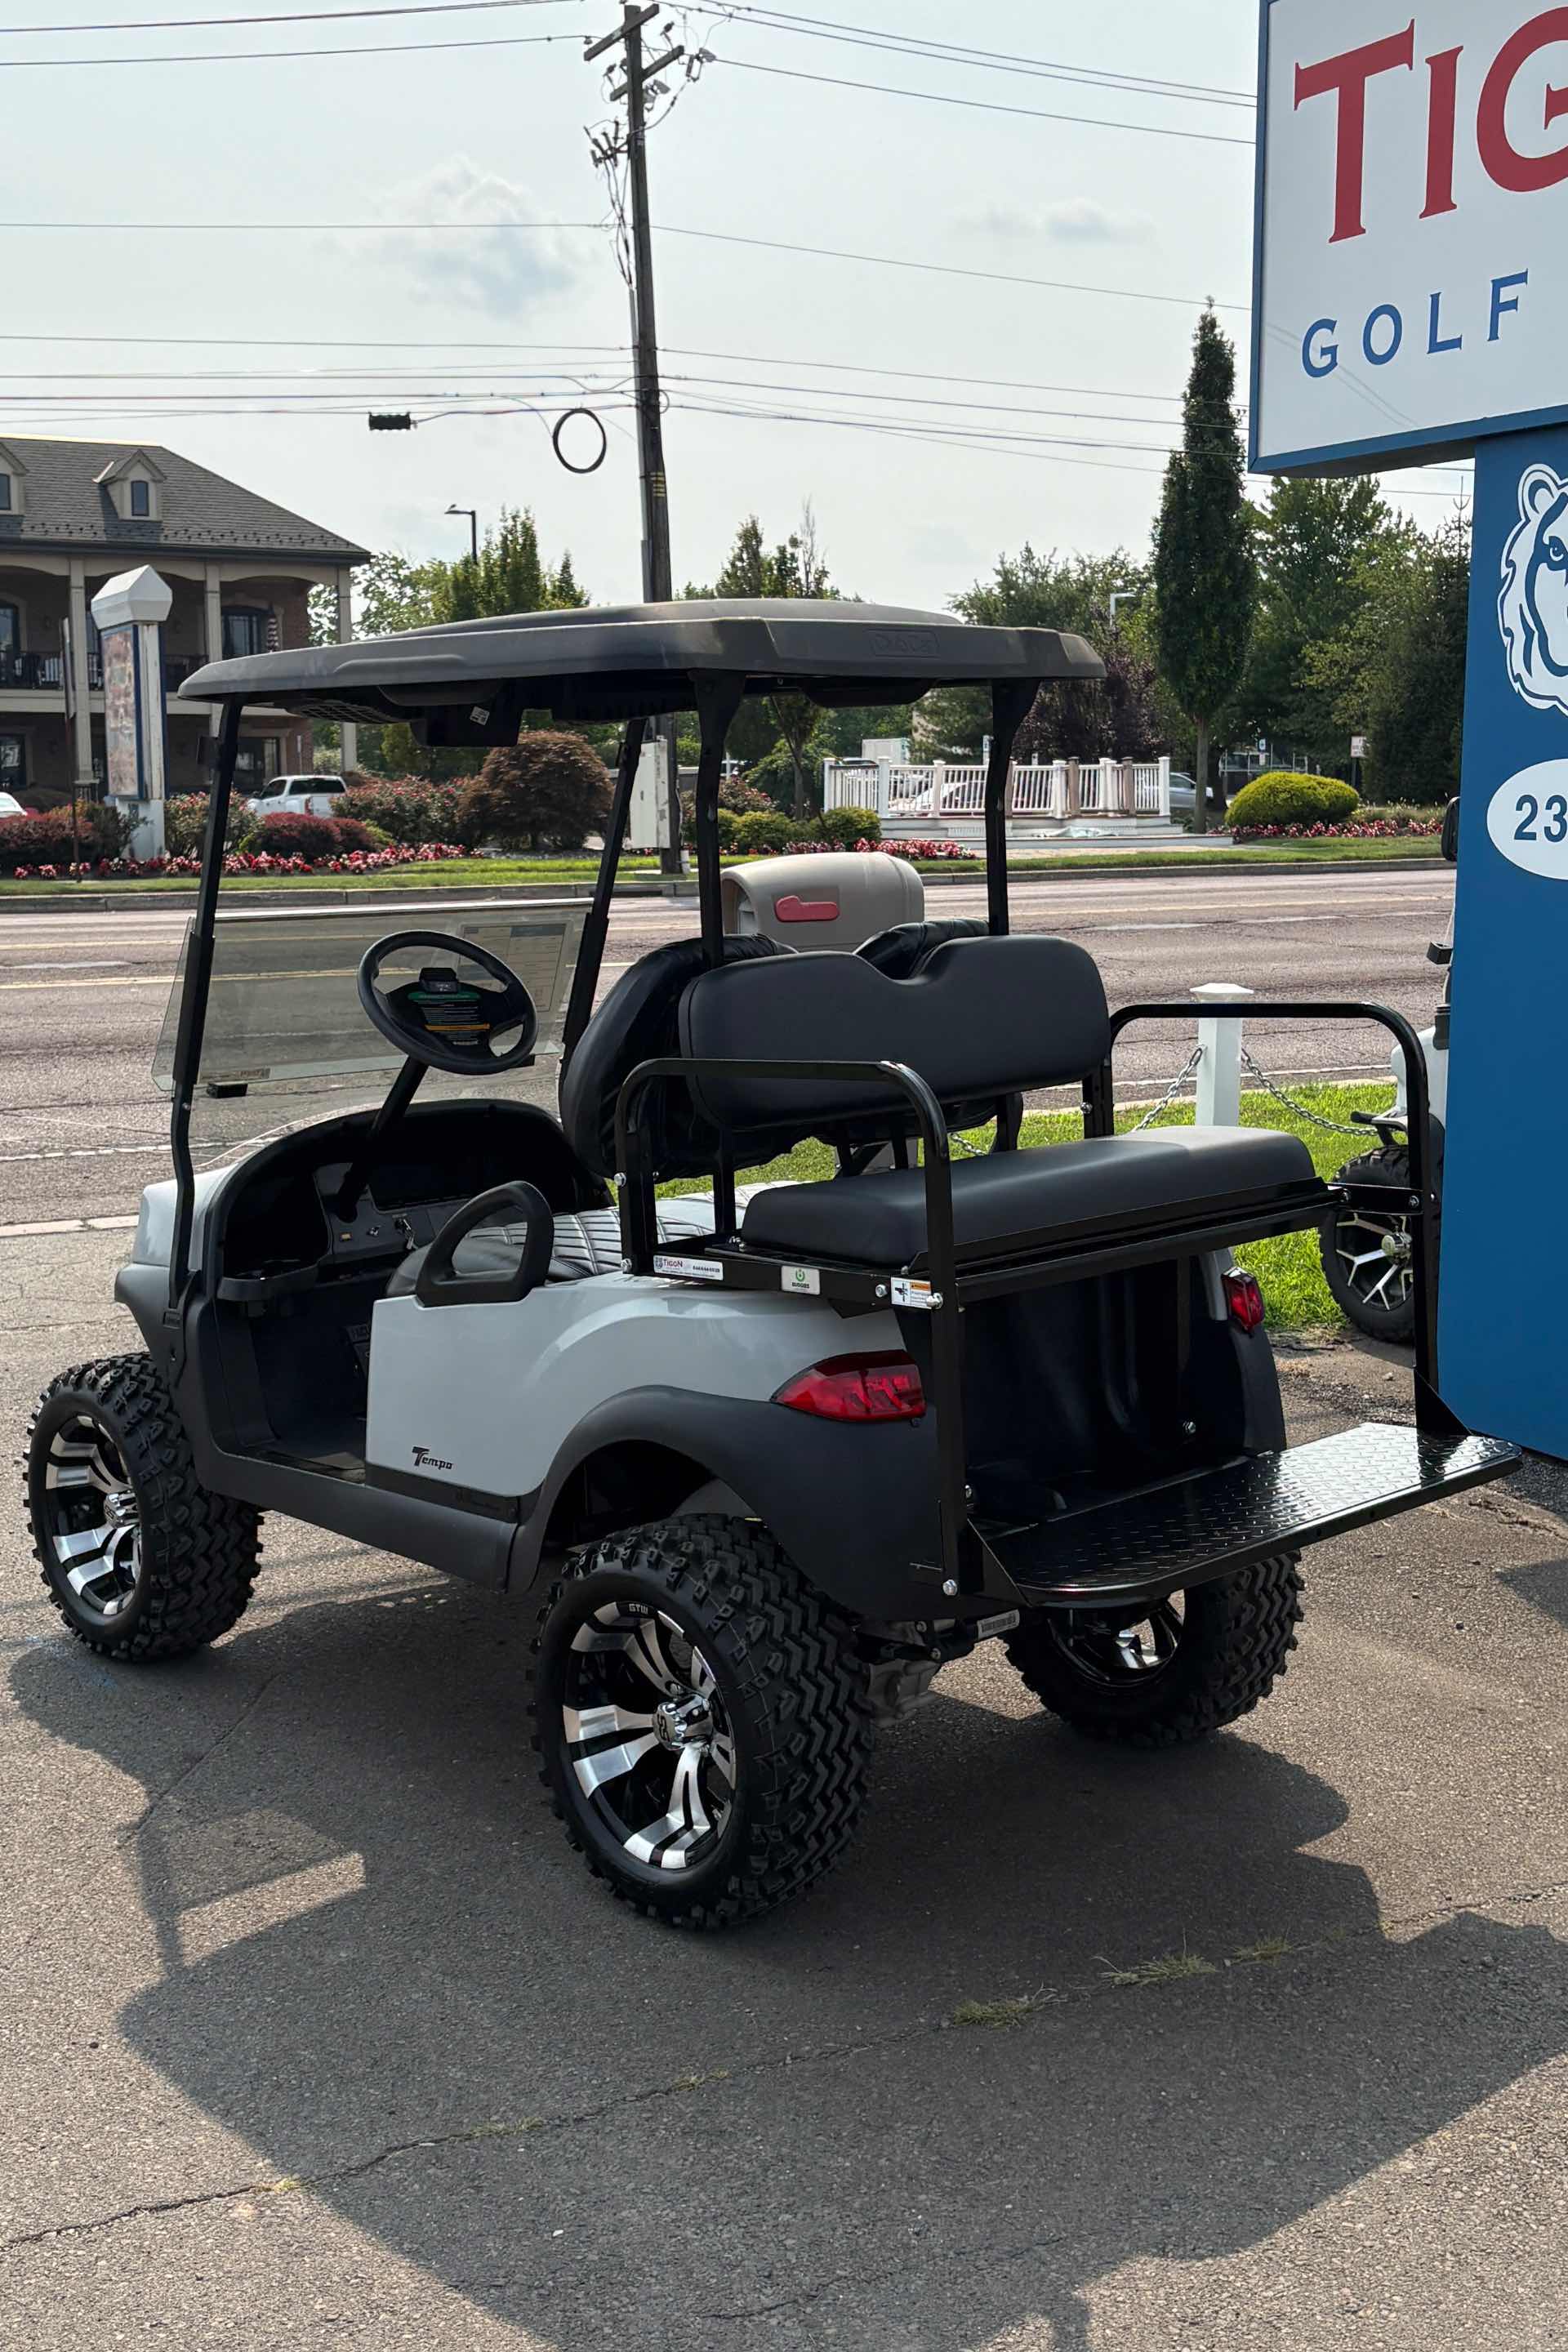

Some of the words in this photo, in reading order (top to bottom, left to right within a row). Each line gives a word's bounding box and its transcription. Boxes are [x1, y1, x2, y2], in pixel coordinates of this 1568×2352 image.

[1294, 7, 1568, 243] TIG
[1302, 268, 1528, 378] GOLF
[1513, 794, 1568, 843] 23
[412, 1446, 454, 1470] Tempo
